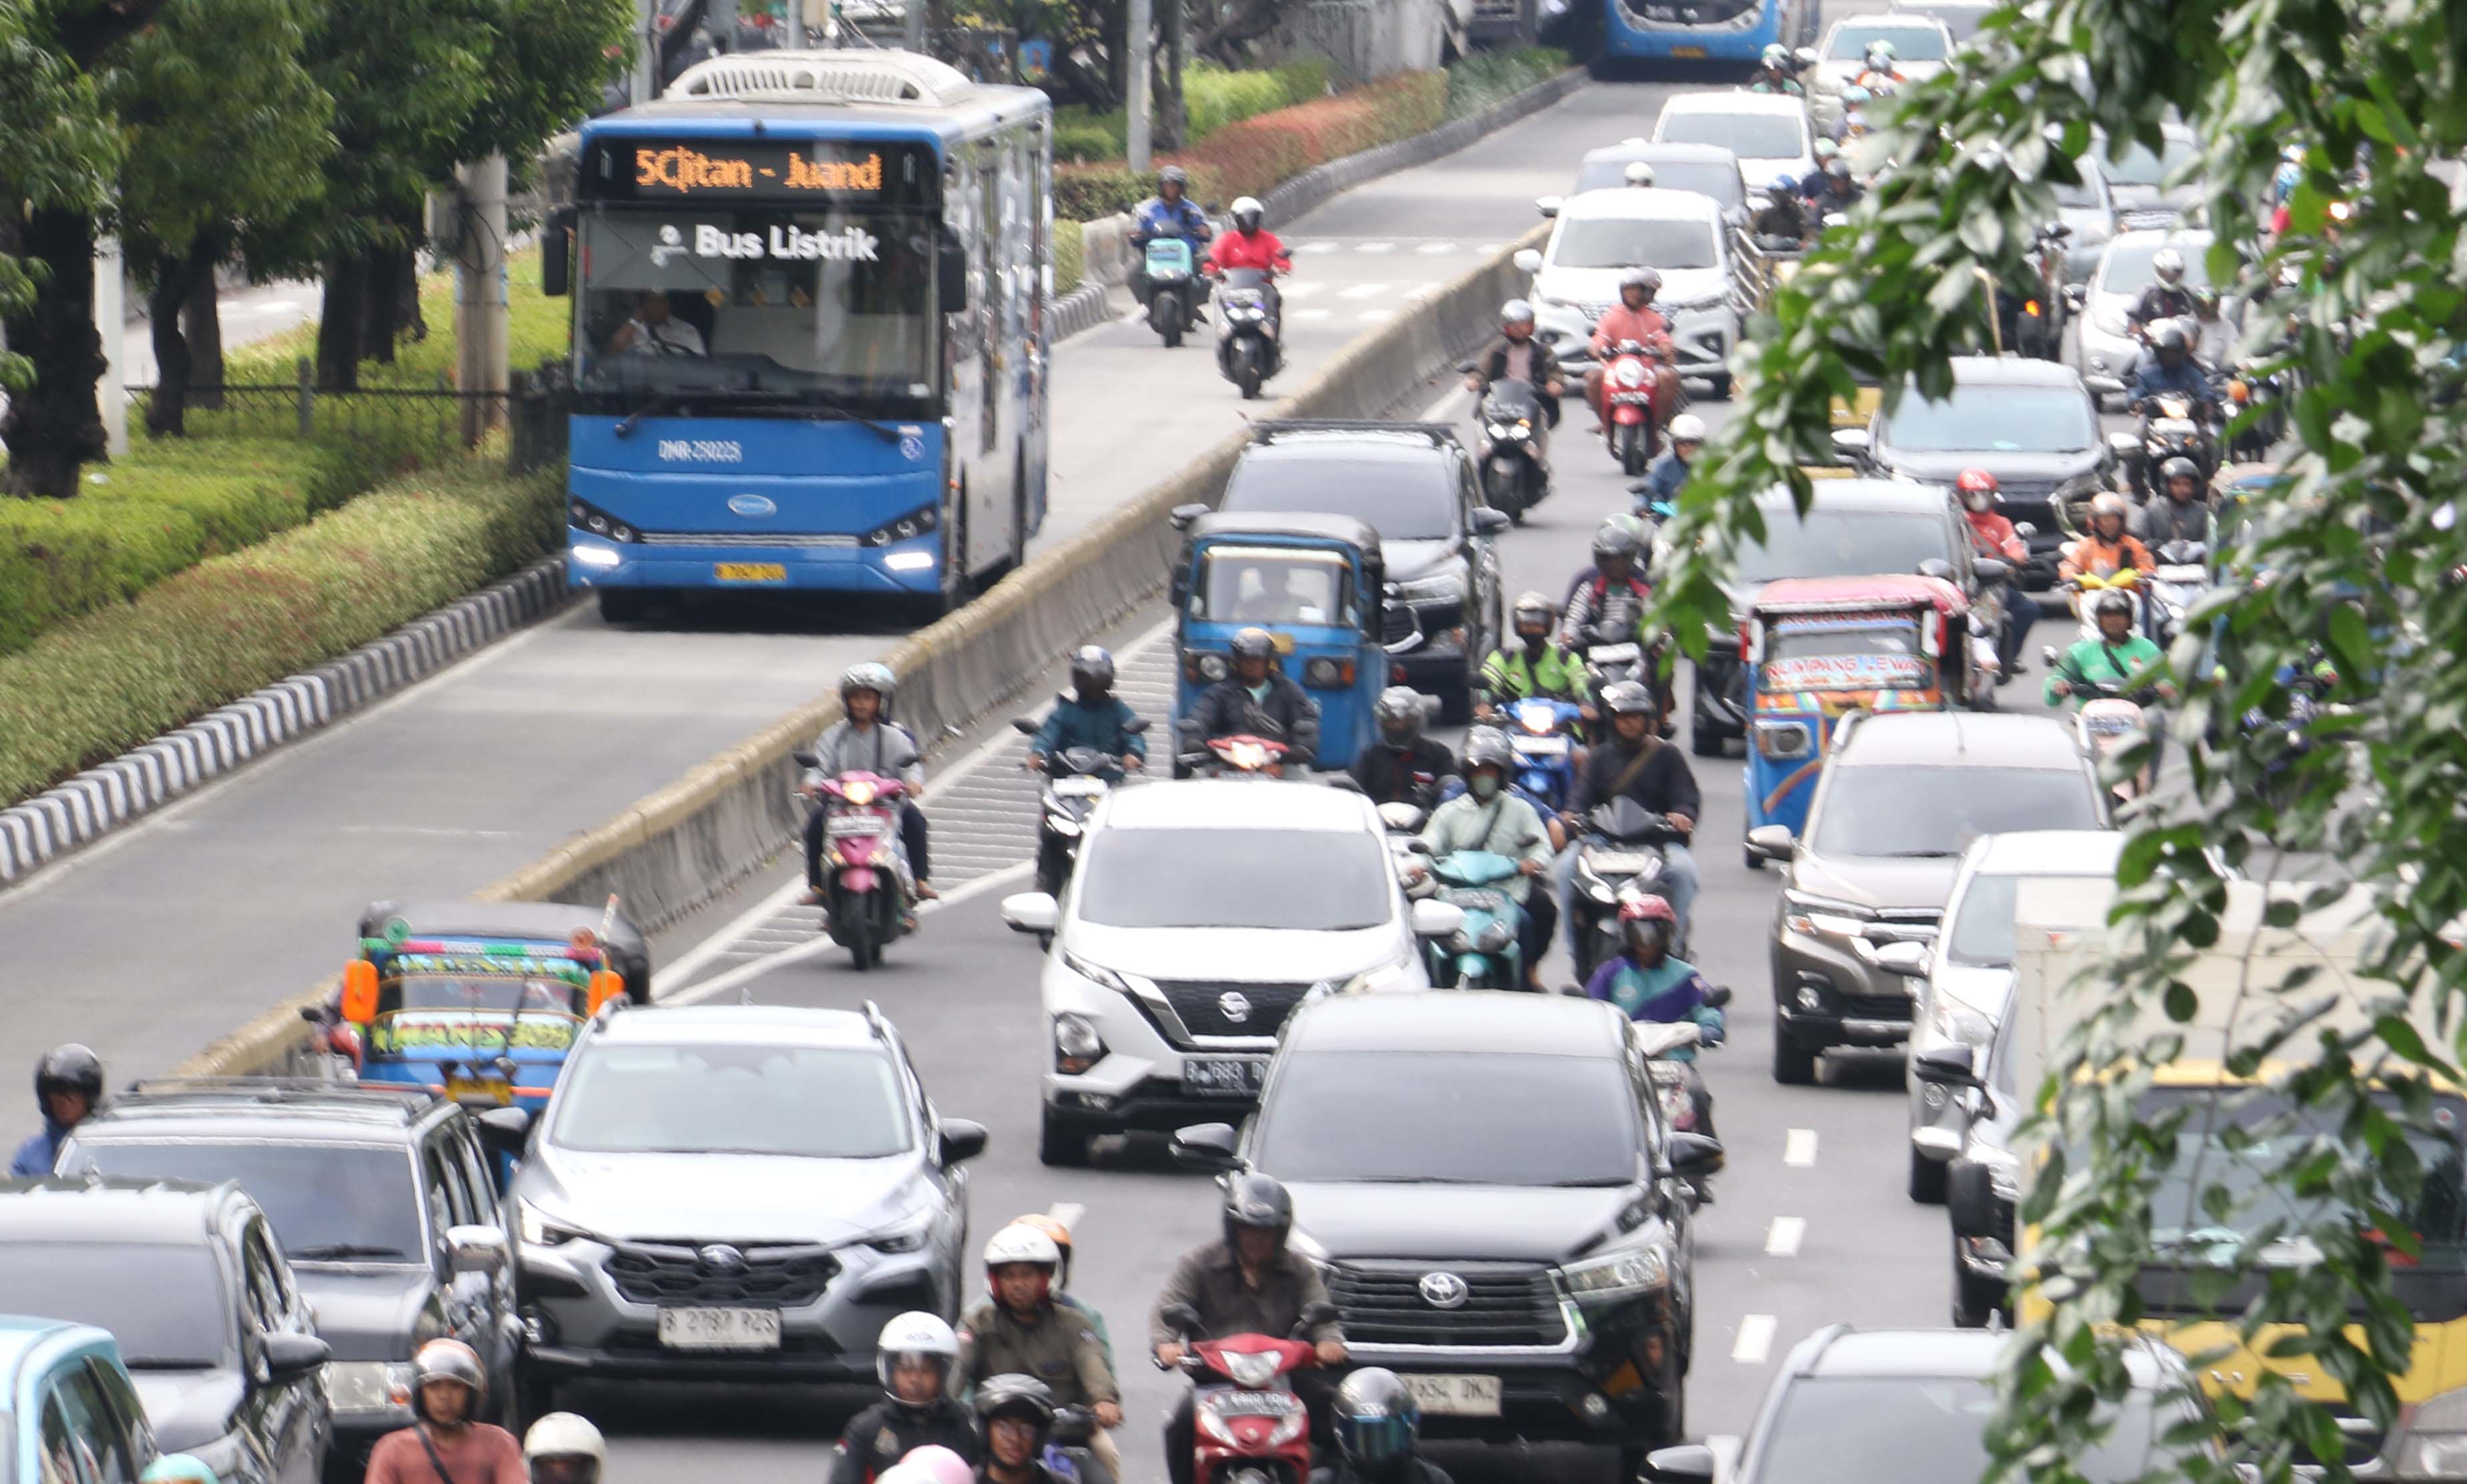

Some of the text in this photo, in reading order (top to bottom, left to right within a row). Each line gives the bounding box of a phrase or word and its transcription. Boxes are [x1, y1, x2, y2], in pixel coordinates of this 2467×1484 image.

[695, 224, 880, 262] Bus Listrik
[1766, 657, 1857, 678] NUMPANG
[1186, 1060, 1199, 1083] B
